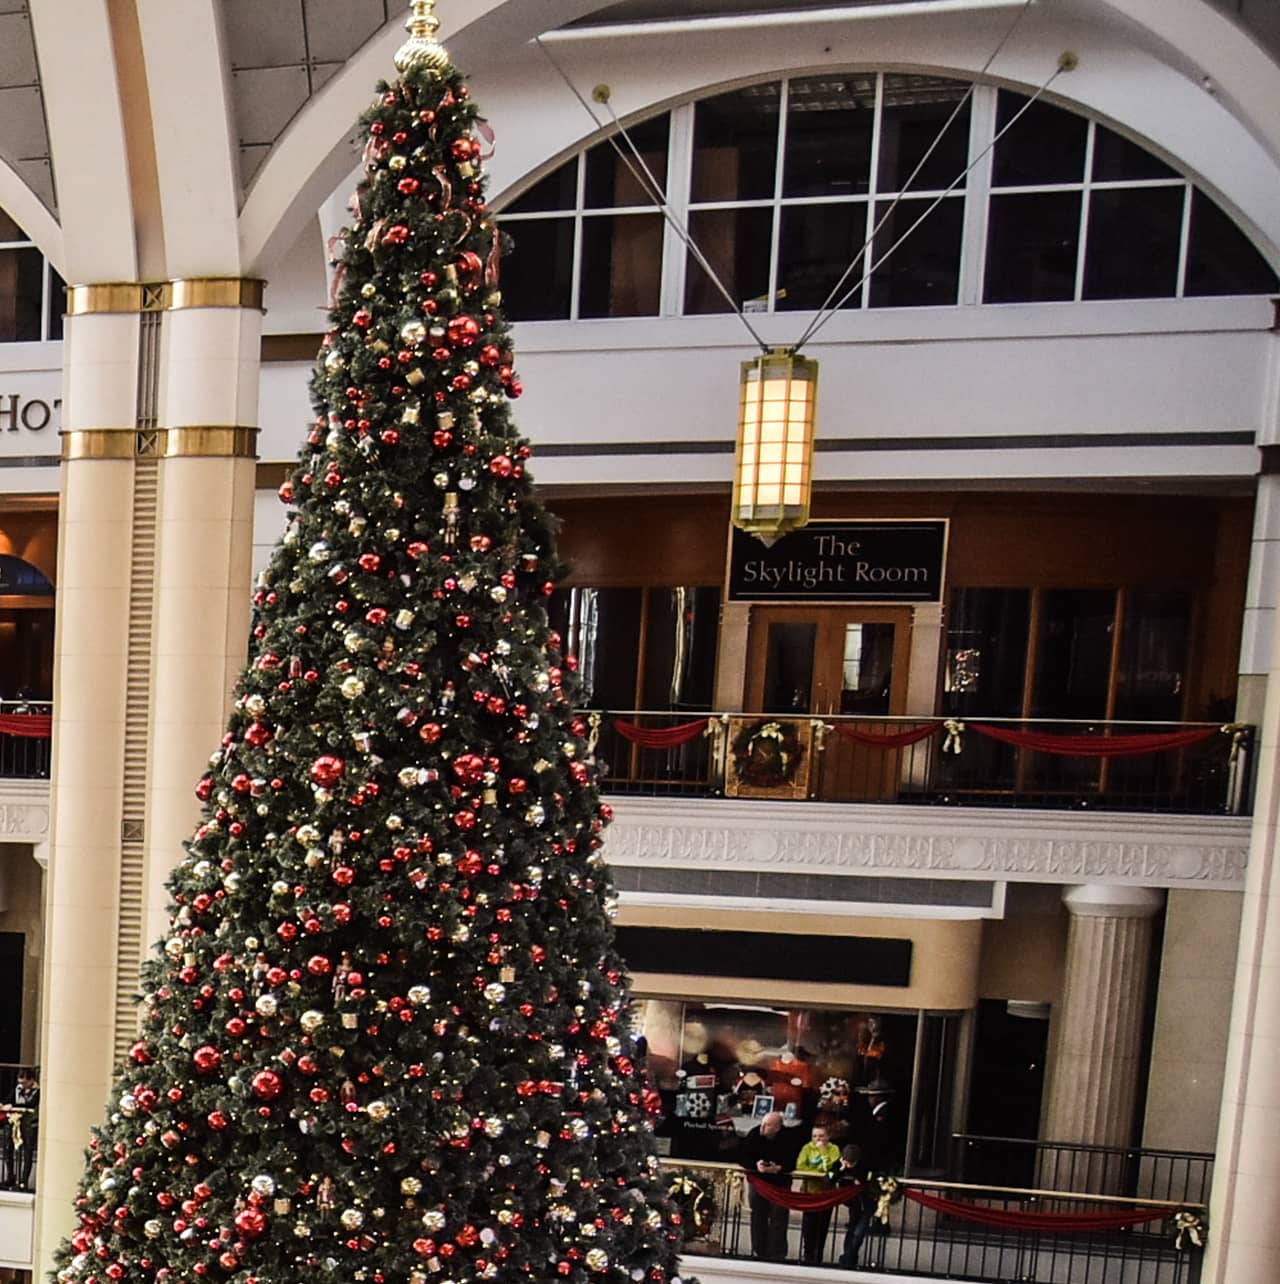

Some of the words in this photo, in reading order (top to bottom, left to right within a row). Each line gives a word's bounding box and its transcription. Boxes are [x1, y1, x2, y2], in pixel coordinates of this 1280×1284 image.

[813, 535, 861, 556] The
[743, 560, 846, 589] Skylight
[855, 561, 928, 582] Room
